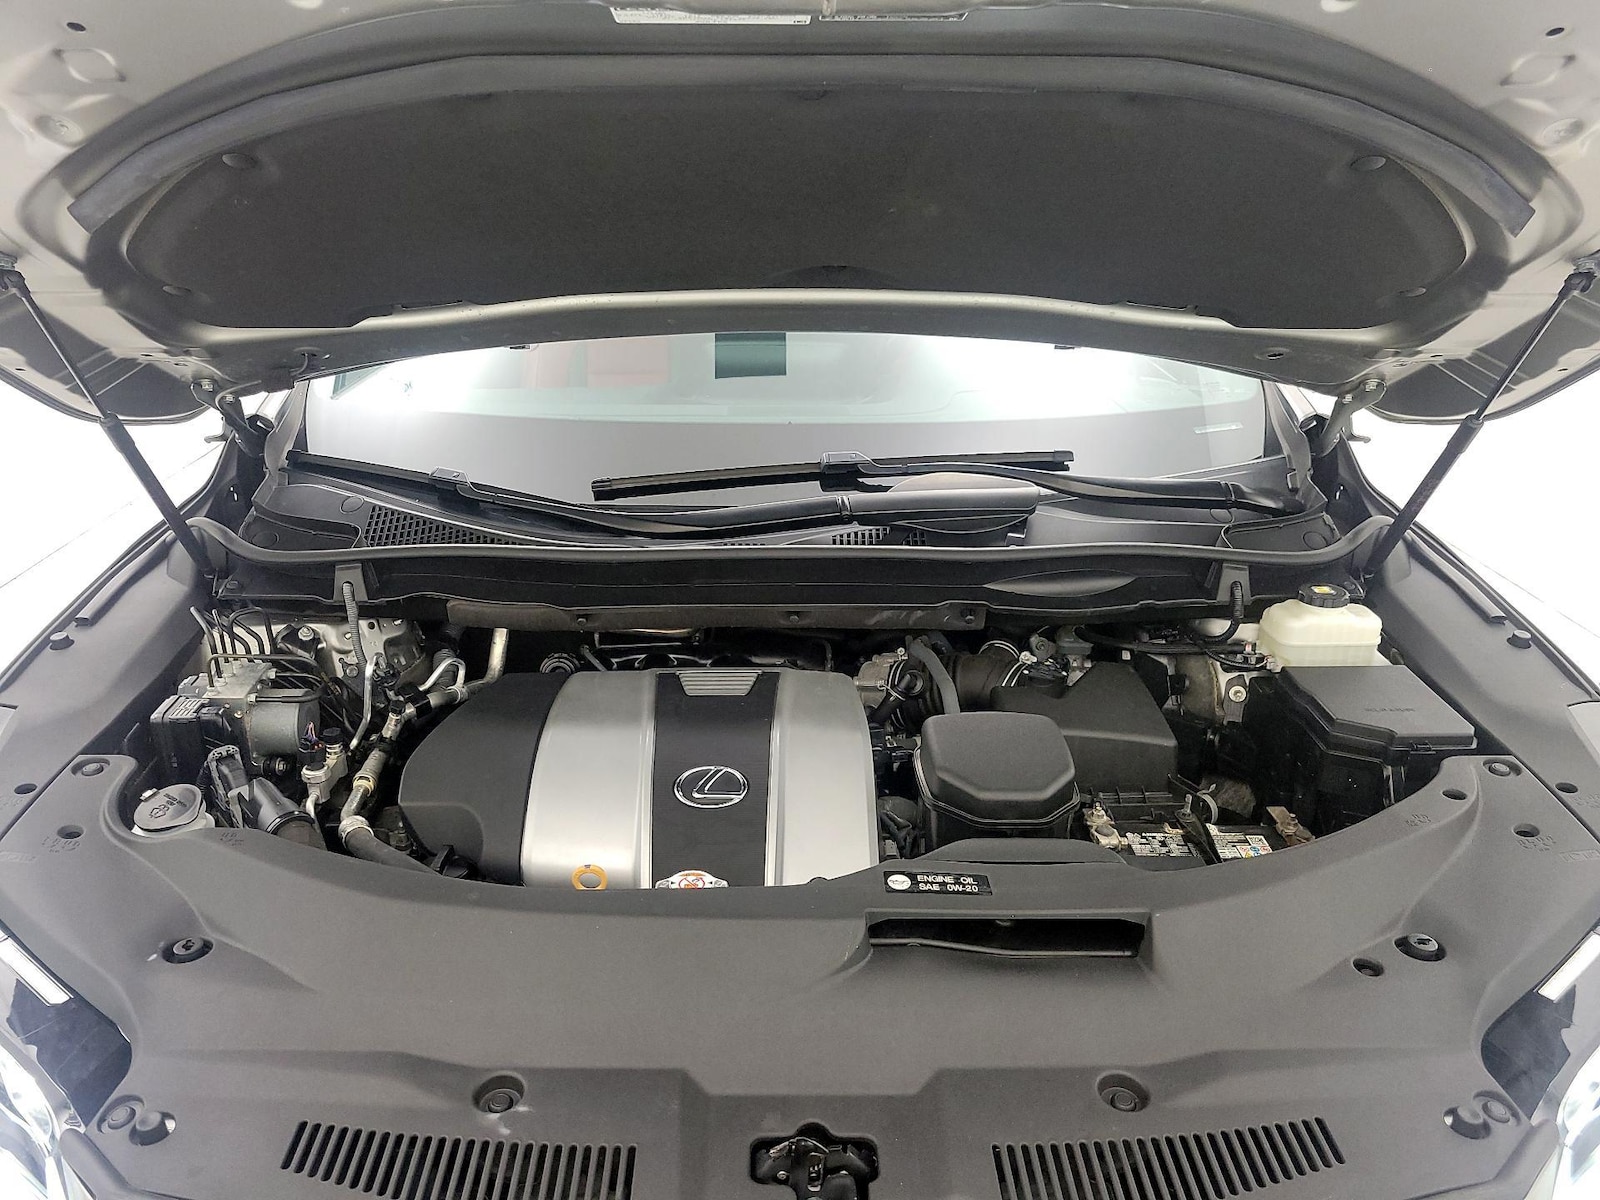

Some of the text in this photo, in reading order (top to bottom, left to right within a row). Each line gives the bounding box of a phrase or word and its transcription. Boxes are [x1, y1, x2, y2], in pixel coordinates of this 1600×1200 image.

[917, 875, 955, 883] ENGINE
[919, 883, 979, 892] SAE 0W-20
